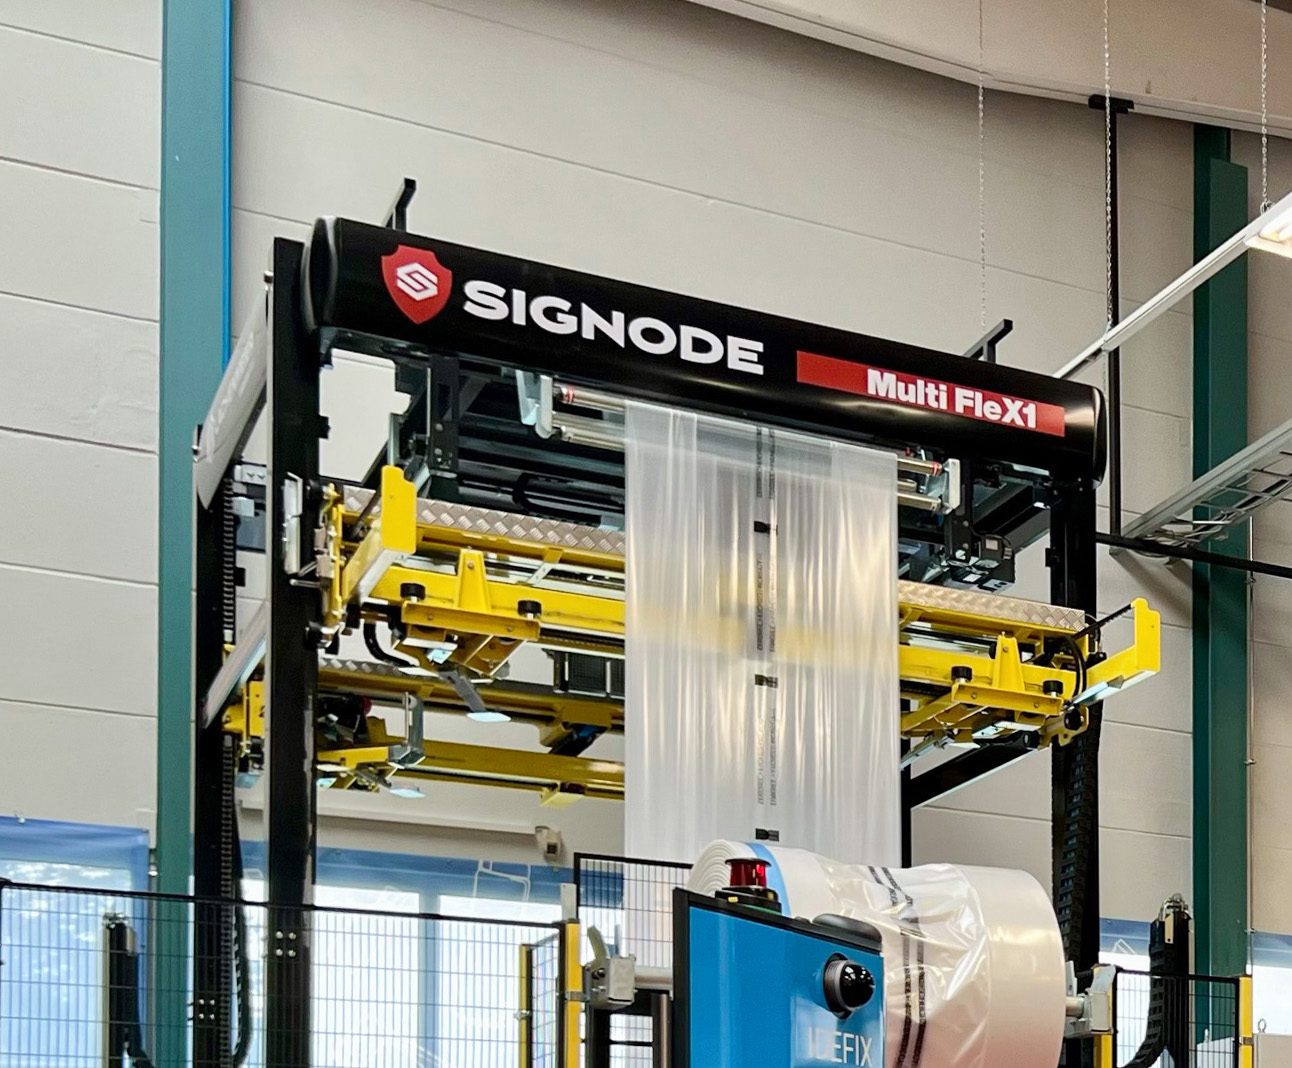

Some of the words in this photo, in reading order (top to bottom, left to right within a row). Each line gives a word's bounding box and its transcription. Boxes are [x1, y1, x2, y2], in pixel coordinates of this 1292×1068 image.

[462, 279, 764, 376] SIGNODE
[866, 368, 948, 410] Multi
[954, 385, 1037, 429] FleX1
[807, 1026, 873, 1067] IDEFIX
